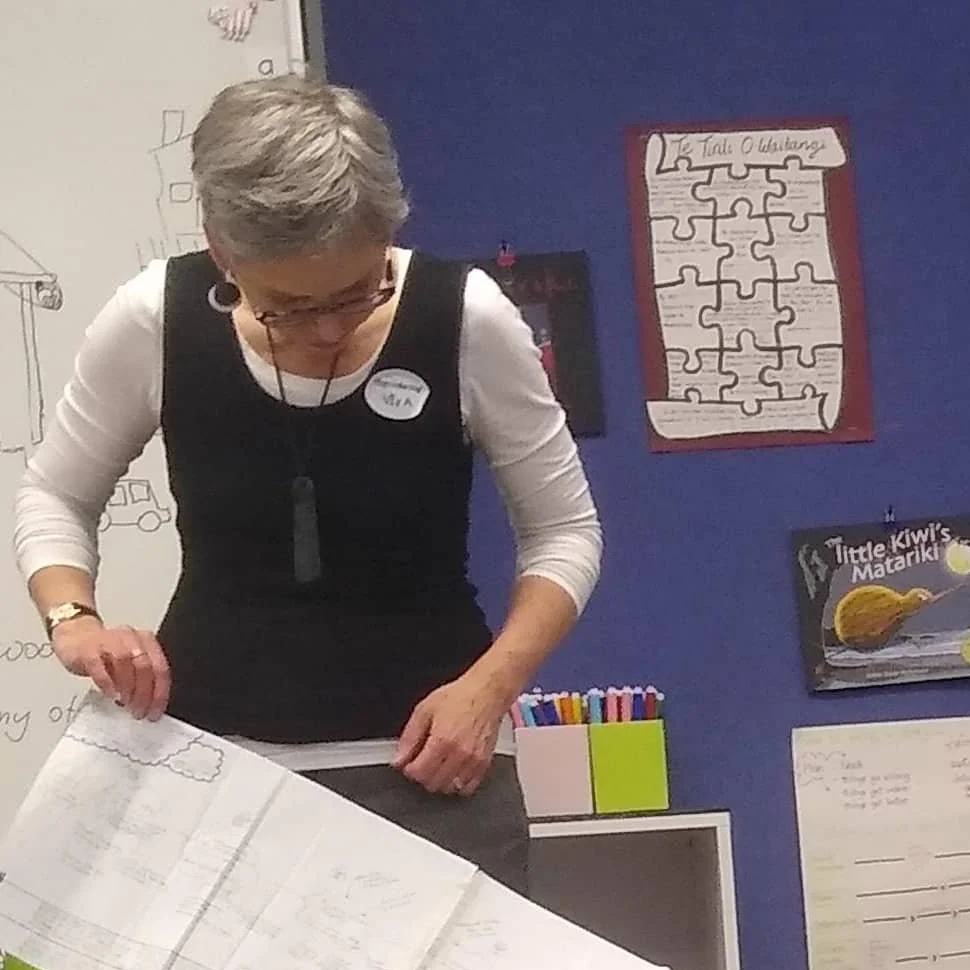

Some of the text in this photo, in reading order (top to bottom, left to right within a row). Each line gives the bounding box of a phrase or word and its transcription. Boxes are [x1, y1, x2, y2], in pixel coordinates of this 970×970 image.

[671, 136, 693, 155] Te
[890, 522, 951, 553] Kiwi's
[852, 542, 939, 583] Matariki
